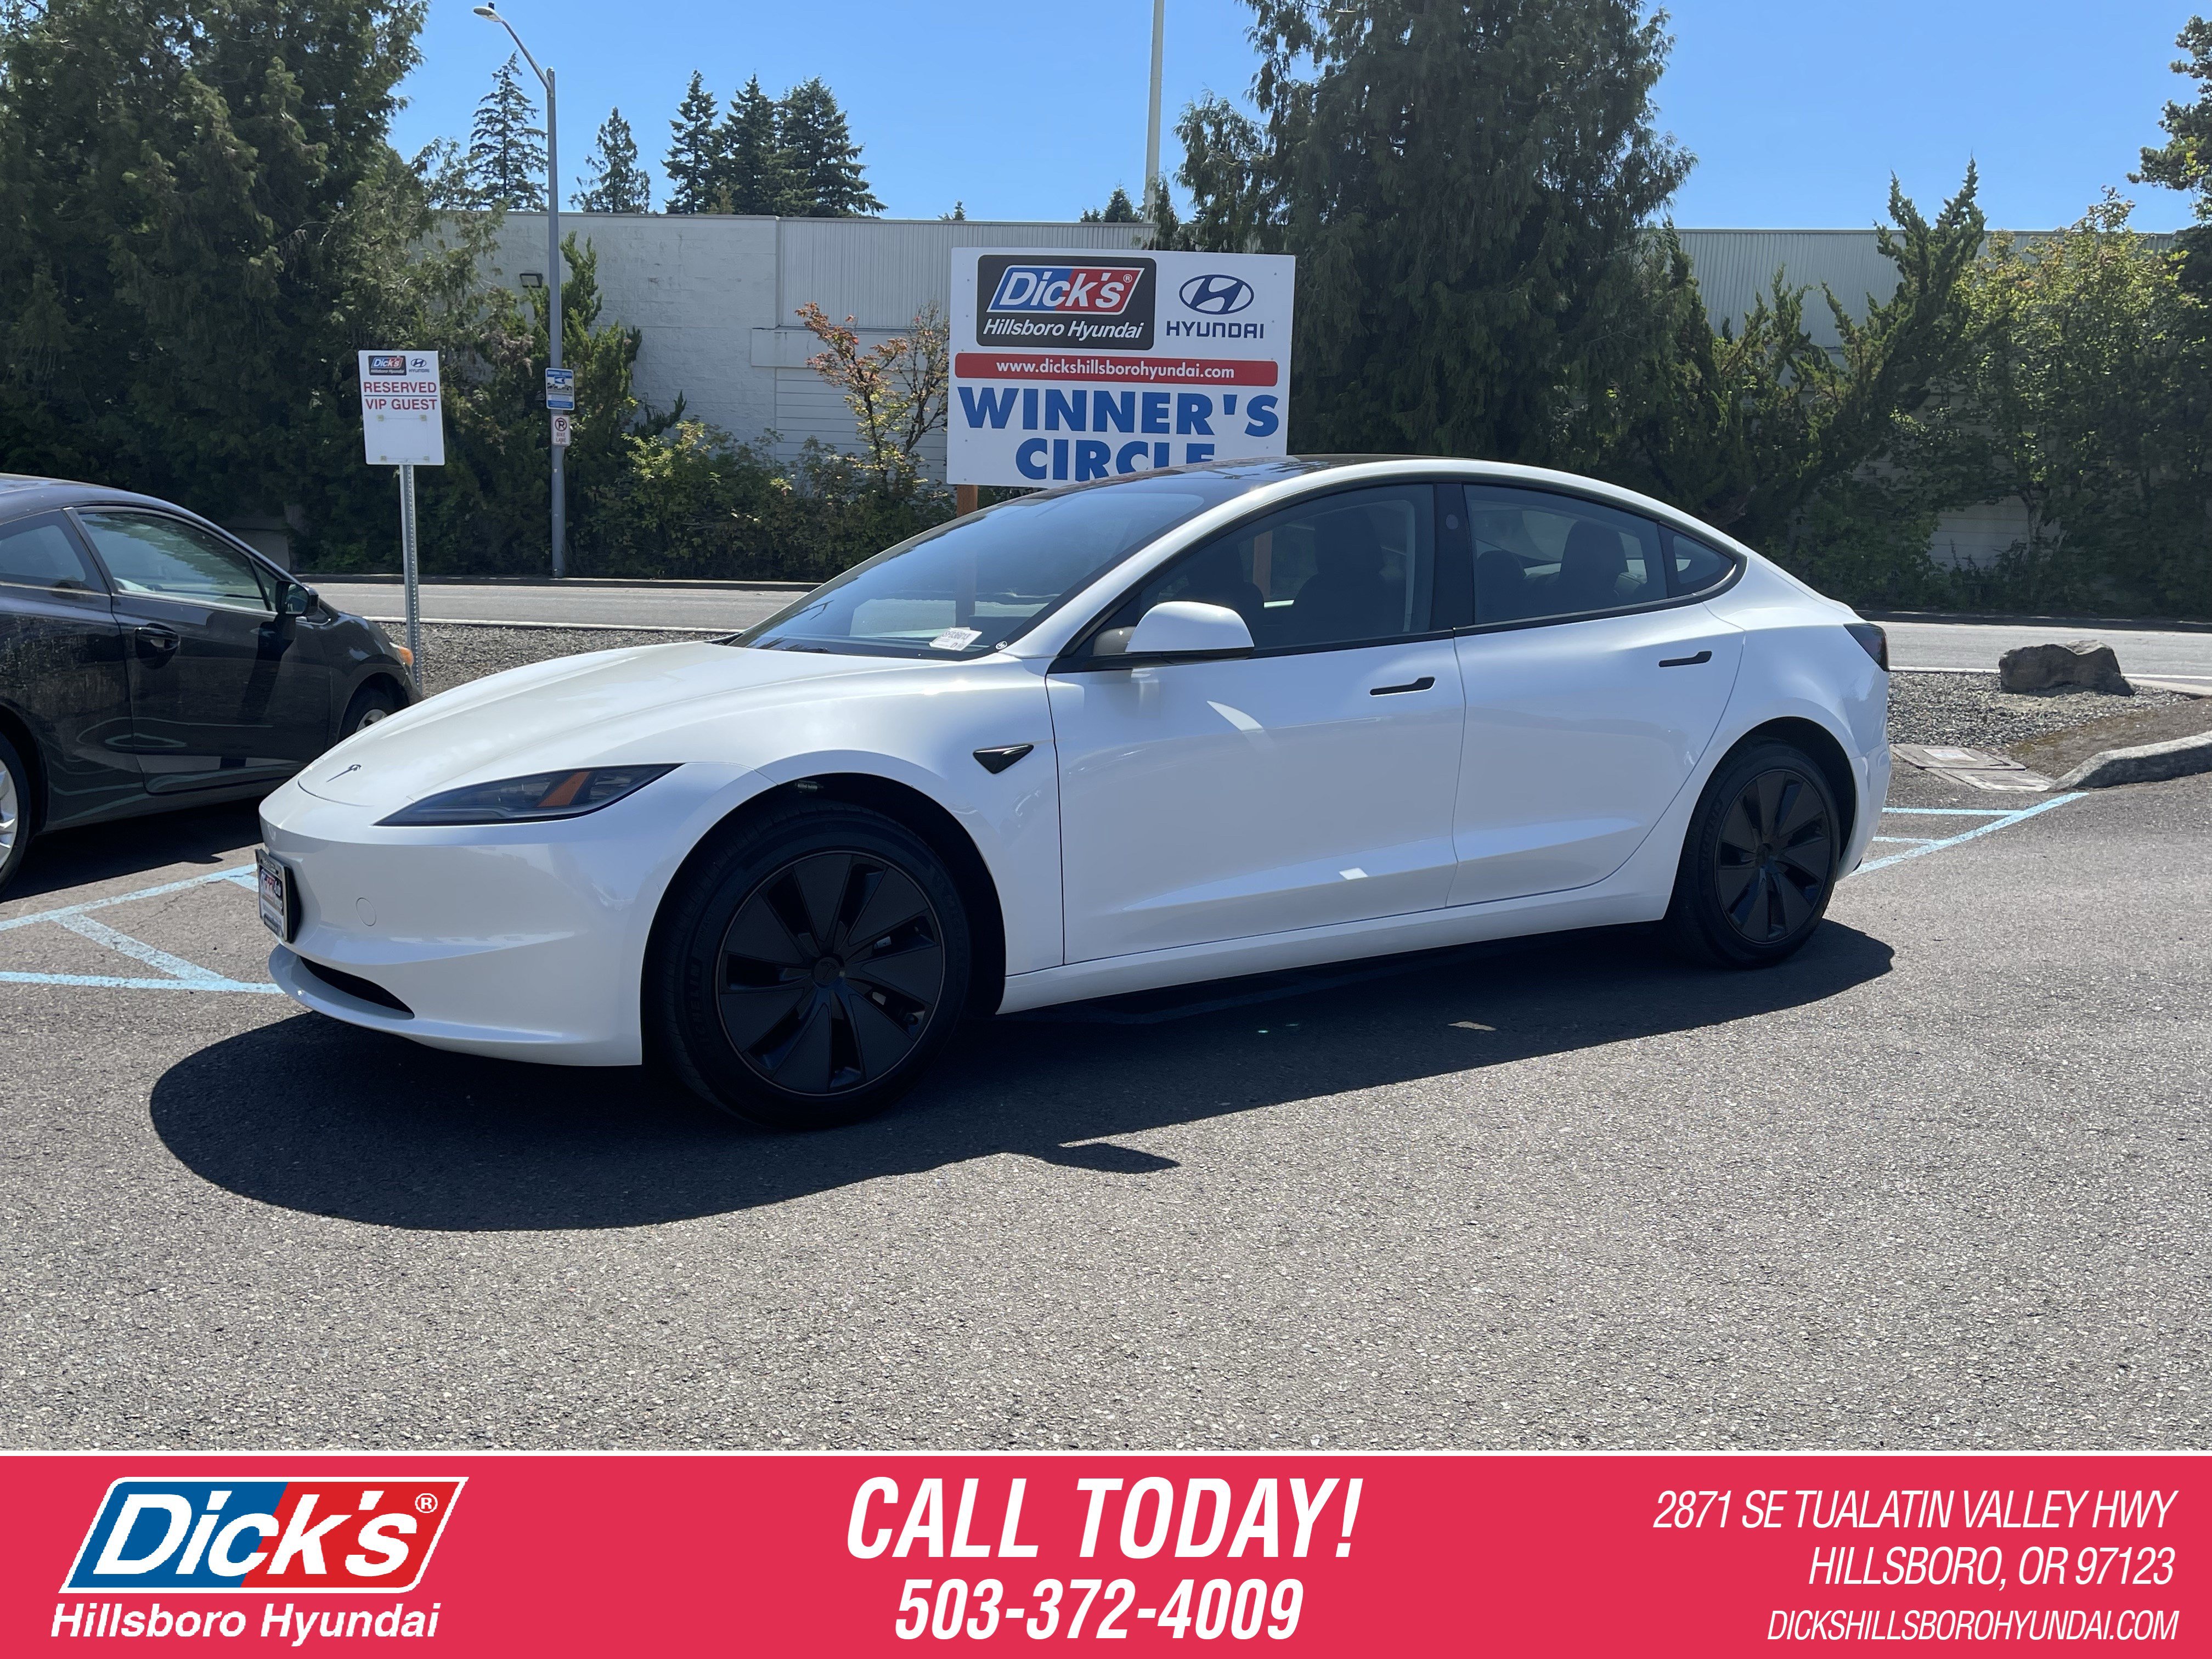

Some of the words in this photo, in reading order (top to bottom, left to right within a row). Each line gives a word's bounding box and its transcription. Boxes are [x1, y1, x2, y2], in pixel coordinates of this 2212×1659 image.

[999, 271, 1125, 308] Dick's
[983, 319, 1064, 336] Hillsboro
[1068, 320, 1144, 341] Hyundai
[1166, 321, 1264, 338] HYUNDAI
[996, 358, 1235, 380] www.dickshillsborohyundai.com
[364, 382, 437, 393] RESERVED
[365, 399, 387, 410] VIP
[391, 399, 437, 410] GUEST
[958, 387, 1279, 437] WINNER'S
